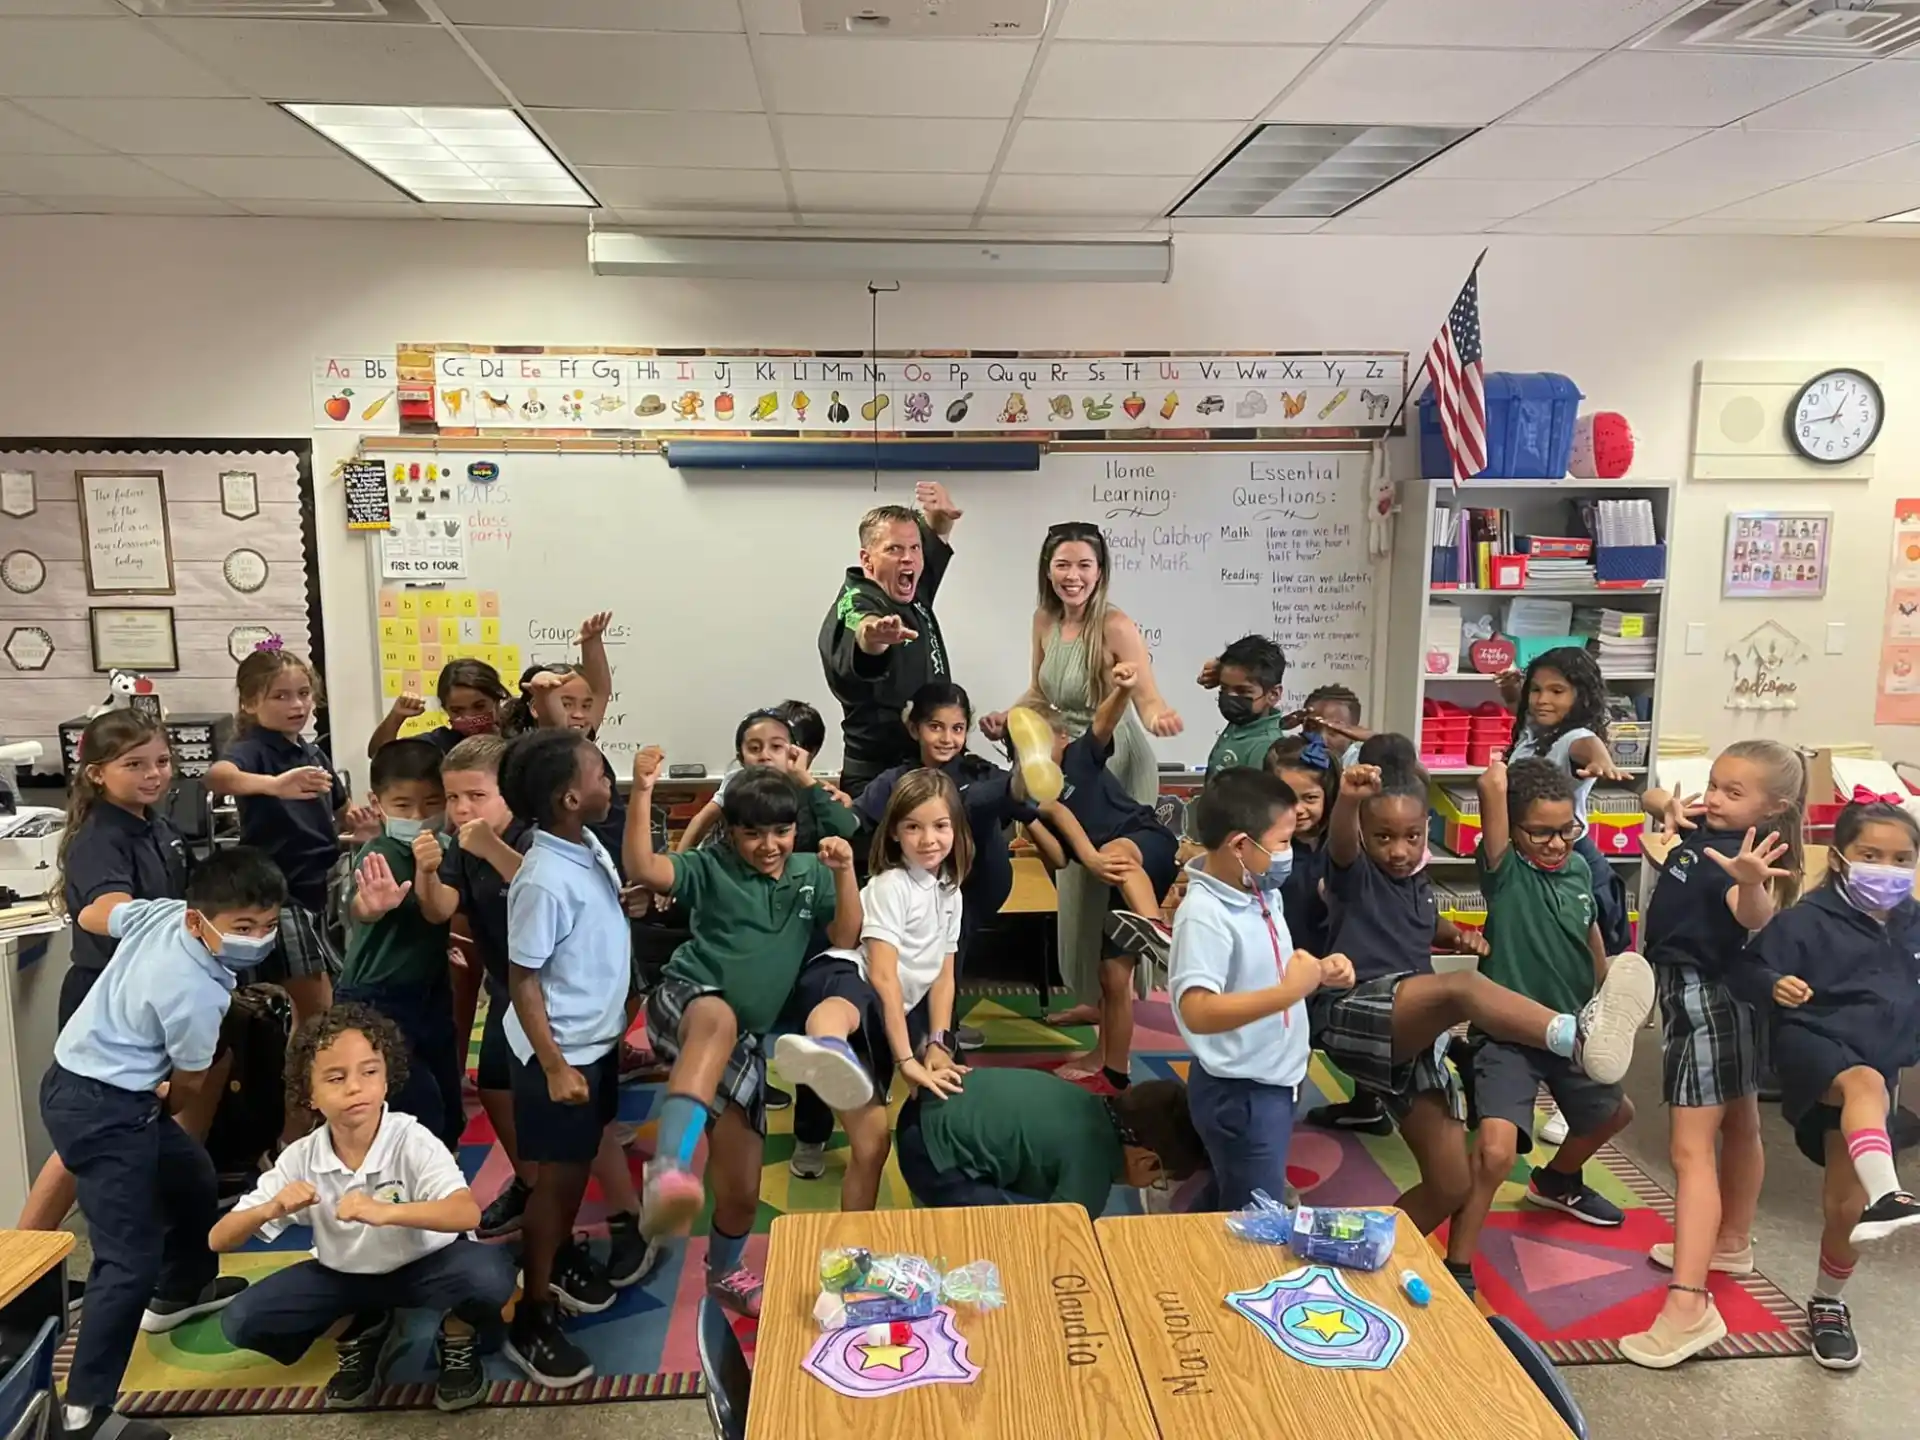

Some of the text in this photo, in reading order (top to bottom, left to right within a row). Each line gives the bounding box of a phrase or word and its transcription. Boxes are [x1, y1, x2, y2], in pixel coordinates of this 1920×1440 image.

[326, 359, 350, 378] Aa
[365, 360, 387, 378] Bb
[443, 358, 465, 377] Cc
[480, 359, 504, 378] Dd
[520, 360, 541, 378] Ee
[560, 360, 578, 378] Ff
[592, 360, 621, 387] Gg
[637, 361, 660, 379] Hh
[676, 361, 695, 380] Ii
[714, 362, 731, 388] Jj
[756, 362, 776, 381] Kk
[794, 362, 807, 381] Ll
[822, 363, 853, 382] Mm
[904, 363, 932, 382] Oo
[950, 363, 969, 390] Pp
[987, 363, 1013, 382] Qu
[1019, 372, 1037, 390] qu
[1051, 363, 1068, 381] Rr
[1088, 363, 1105, 381] Ss
[1121, 362, 1140, 380] Tt
[1159, 362, 1179, 380] Uu
[1200, 362, 1221, 379] Vv
[1236, 361, 1267, 379] Ww
[1282, 361, 1303, 379] Xx
[1323, 361, 1345, 387] Yy
[1366, 361, 1384, 378] Zz
[1821, 383, 1829, 395] 11
[1835, 380, 1846, 391] 12
[1852, 384, 1856, 395] 1
[1808, 394, 1819, 405] 10
[1859, 394, 1868, 406] 2
[1800, 410, 1808, 420] 9
[1861, 410, 1869, 422] 3
[1802, 426, 1810, 437] 8
[1853, 428, 1861, 438] 4
[1813, 437, 1820, 448] 7
[1826, 441, 1835, 451] 6
[1842, 437, 1850, 448] 5
[1106, 460, 1155, 479] Home
[1251, 460, 1340, 481] Essential
[91, 488, 144, 503] The future
[1092, 485, 1177, 511] Learning:
[1233, 486, 1336, 507] Questions:
[107, 505, 137, 520] of the
[469, 510, 508, 527] class
[98, 521, 123, 534] world
[1266, 526, 1287, 538] How
[1292, 529, 1308, 537] can
[1313, 528, 1329, 536] we
[1334, 524, 1350, 536] tell
[94, 538, 161, 555] my classroom
[470, 530, 511, 549] party
[1103, 525, 1212, 555] Ready Catch-up
[1266, 540, 1288, 549] time
[1306, 539, 1320, 548] the
[1325, 538, 1342, 548] hour
[115, 554, 143, 571] today
[1151, 553, 1189, 571] Math
[1268, 551, 1291, 562] half
[1221, 568, 1264, 585] Reading:
[1273, 571, 1293, 583] How
[1298, 575, 1315, 583] can
[1319, 575, 1334, 583] we
[1272, 584, 1312, 593] relevant
[1272, 600, 1291, 612] How
[1331, 601, 1366, 617] identify
[529, 620, 575, 648] Group
[1273, 631, 1292, 640] How
[1051, 1273, 1110, 1366] Claudia
